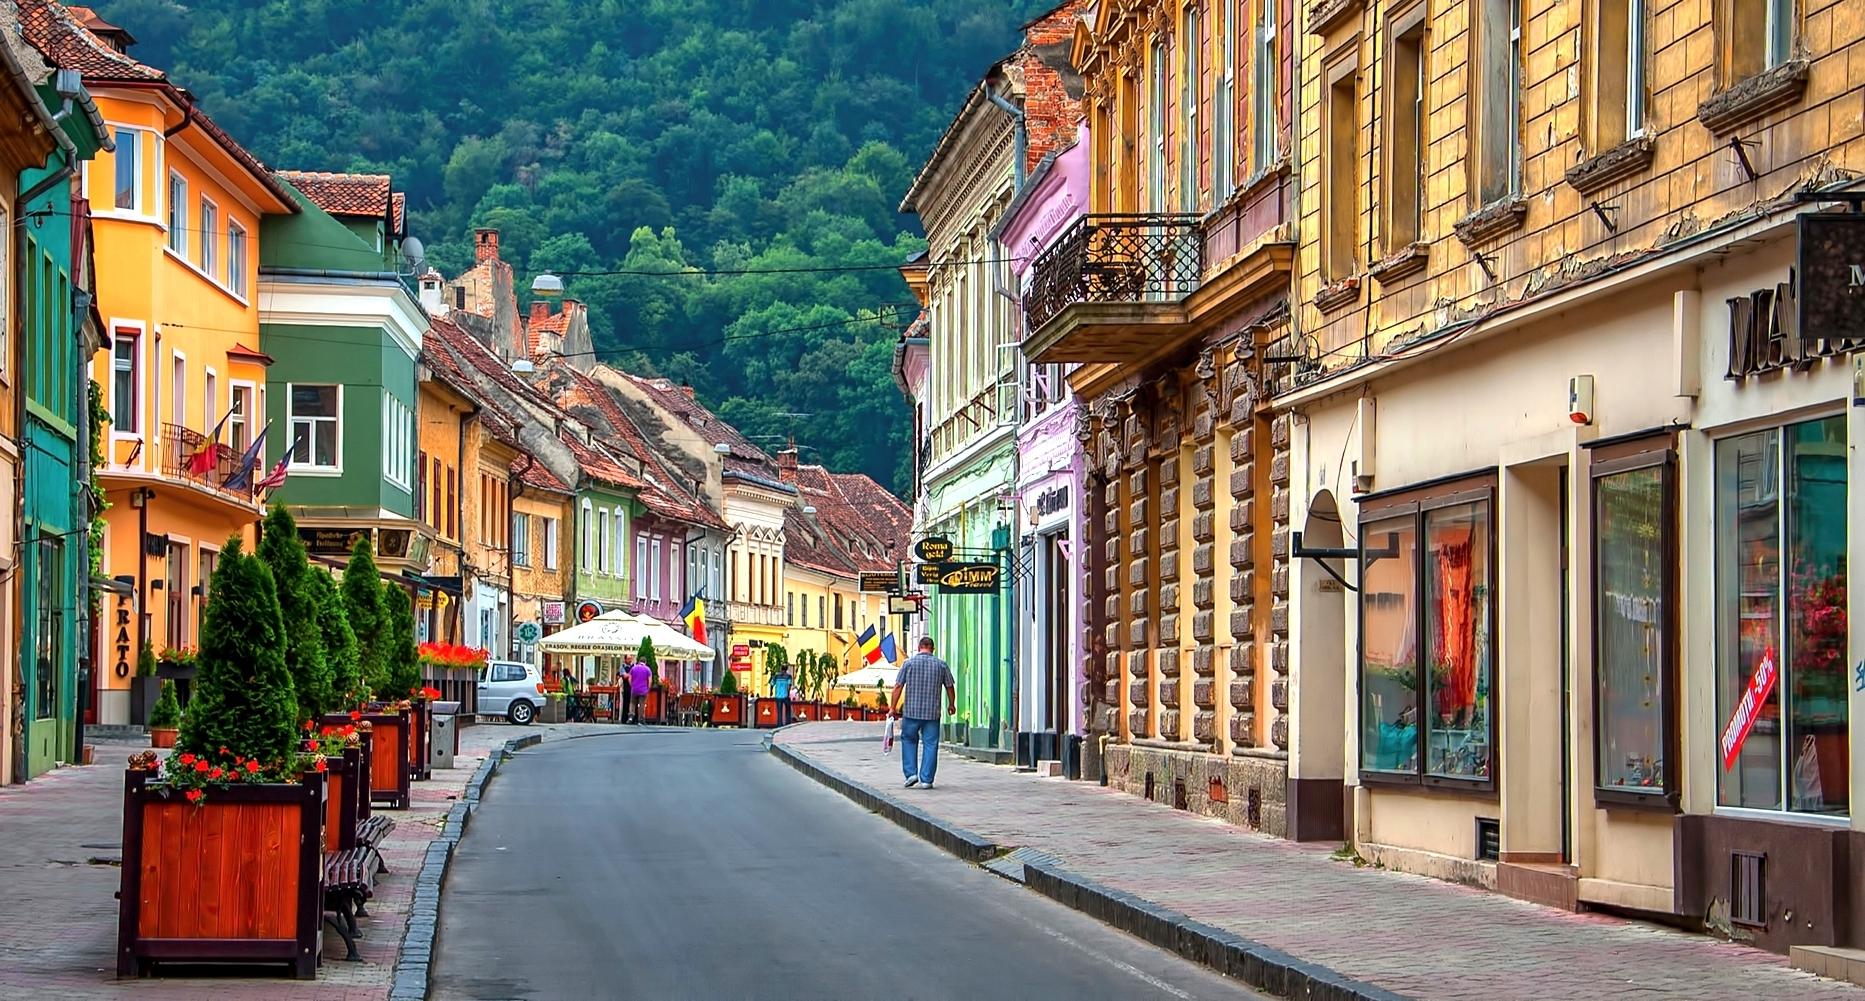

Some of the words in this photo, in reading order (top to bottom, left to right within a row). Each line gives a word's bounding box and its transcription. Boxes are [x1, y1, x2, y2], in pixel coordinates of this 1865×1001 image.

[922, 541, 948, 550] Roma
[925, 550, 944, 559] gold
[1754, 652, 1774, 694] -50%
